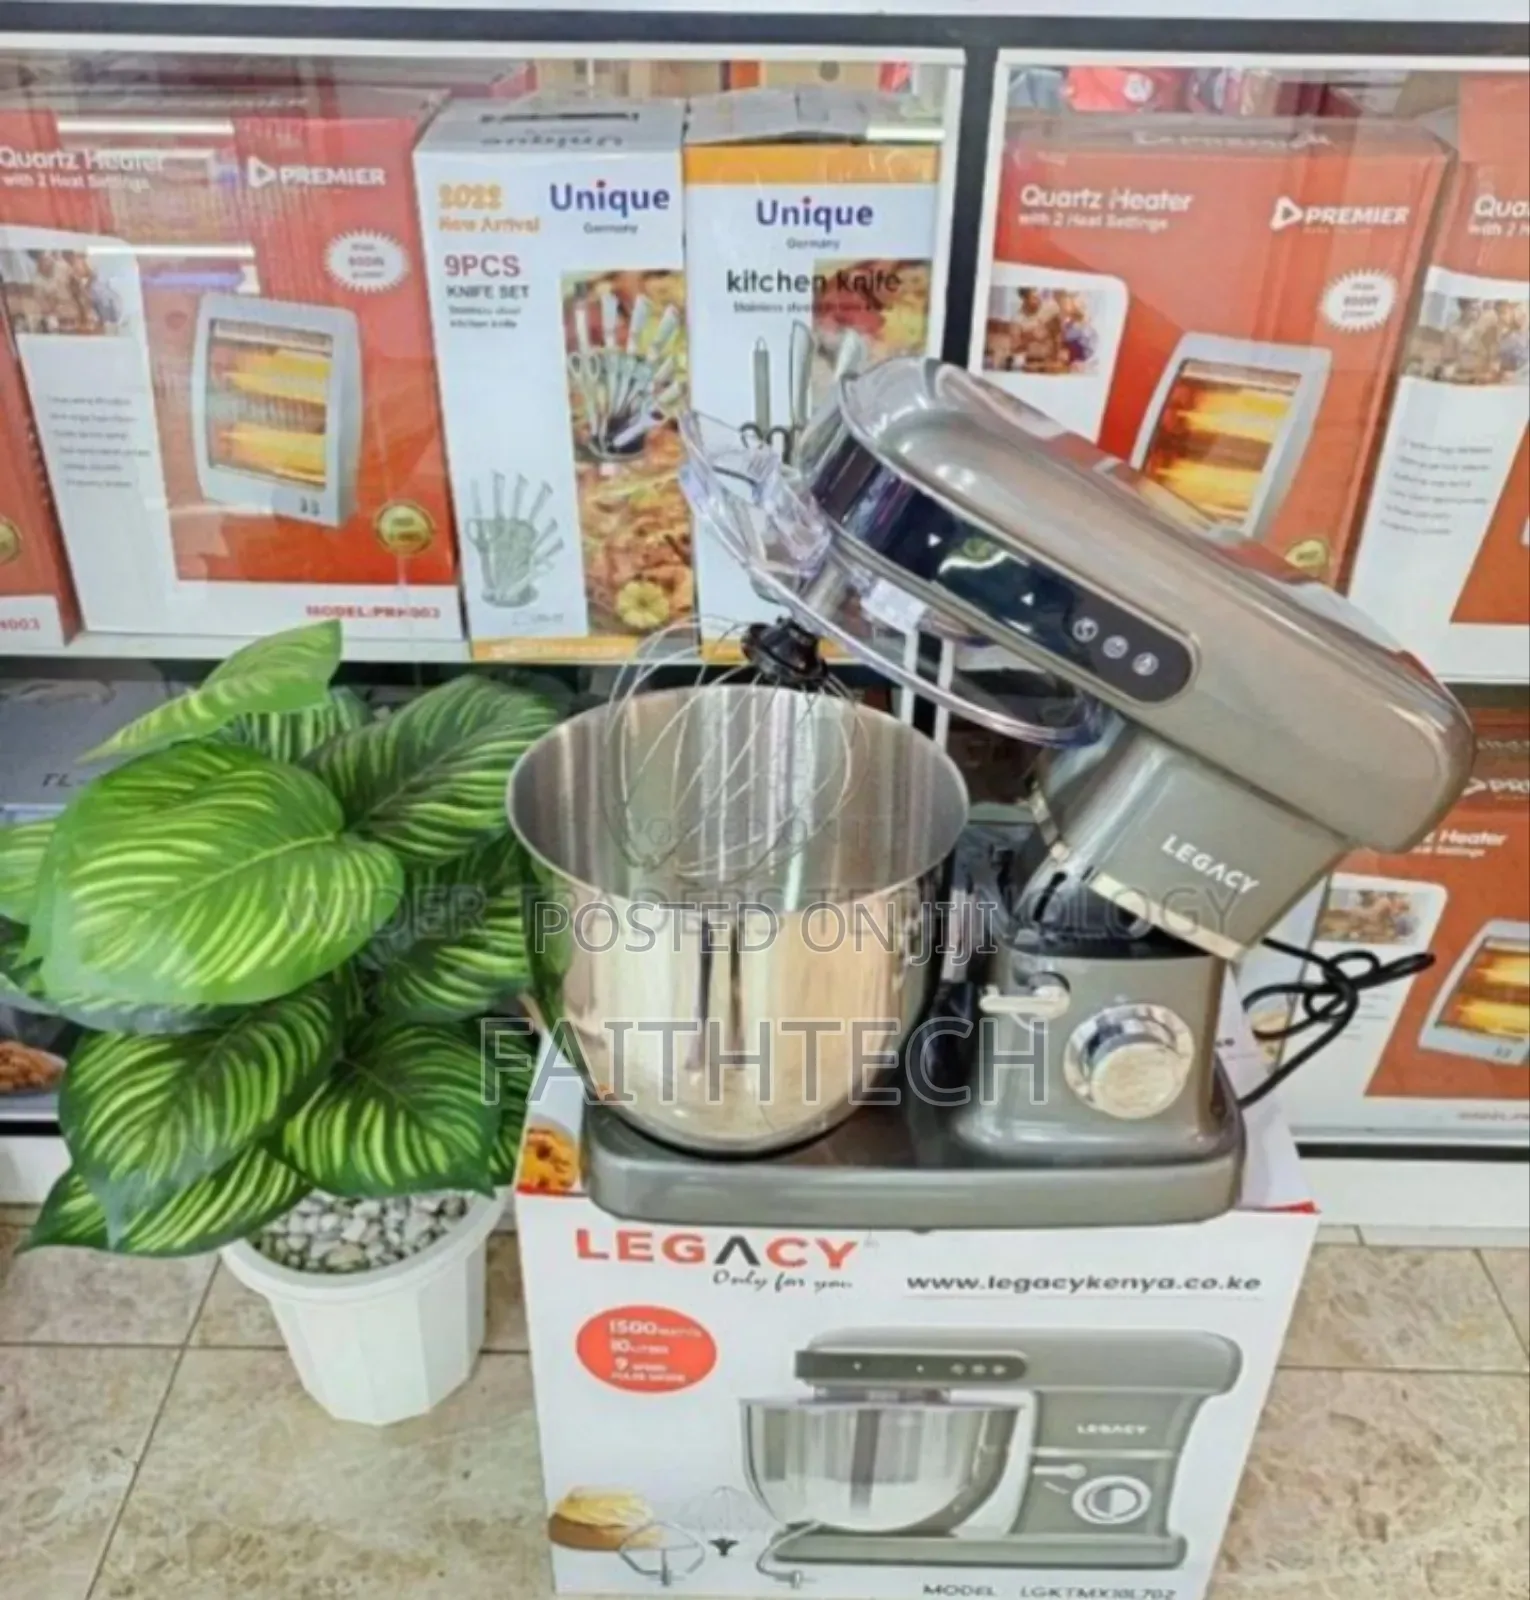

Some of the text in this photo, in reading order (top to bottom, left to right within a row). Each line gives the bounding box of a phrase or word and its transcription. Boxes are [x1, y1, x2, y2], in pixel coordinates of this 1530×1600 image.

[0, 146, 79, 170] Quartz
[280, 166, 386, 186] PREMIER
[550, 180, 671, 218] Unique
[1020, 184, 1194, 212] Quartz Heater
[481, 216, 540, 233] Arrival
[756, 196, 874, 233] Unique
[1019, 212, 1050, 227] with
[1106, 215, 1170, 233] Settings
[1305, 206, 1411, 226] PREMIER
[583, 222, 638, 235] Germany
[786, 236, 840, 250] Germany
[444, 255, 521, 278] 9PCS
[726, 268, 903, 294] kitchen knife
[446, 284, 530, 300] KNIFE SET
[1160, 832, 1262, 894] LEGACY
[575, 1228, 859, 1270] LEGACY
[905, 1274, 1263, 1294] www.legacykenya.co.ke
[1077, 1422, 1150, 1435] LEGACY
[922, 1584, 998, 1598] MODEL
